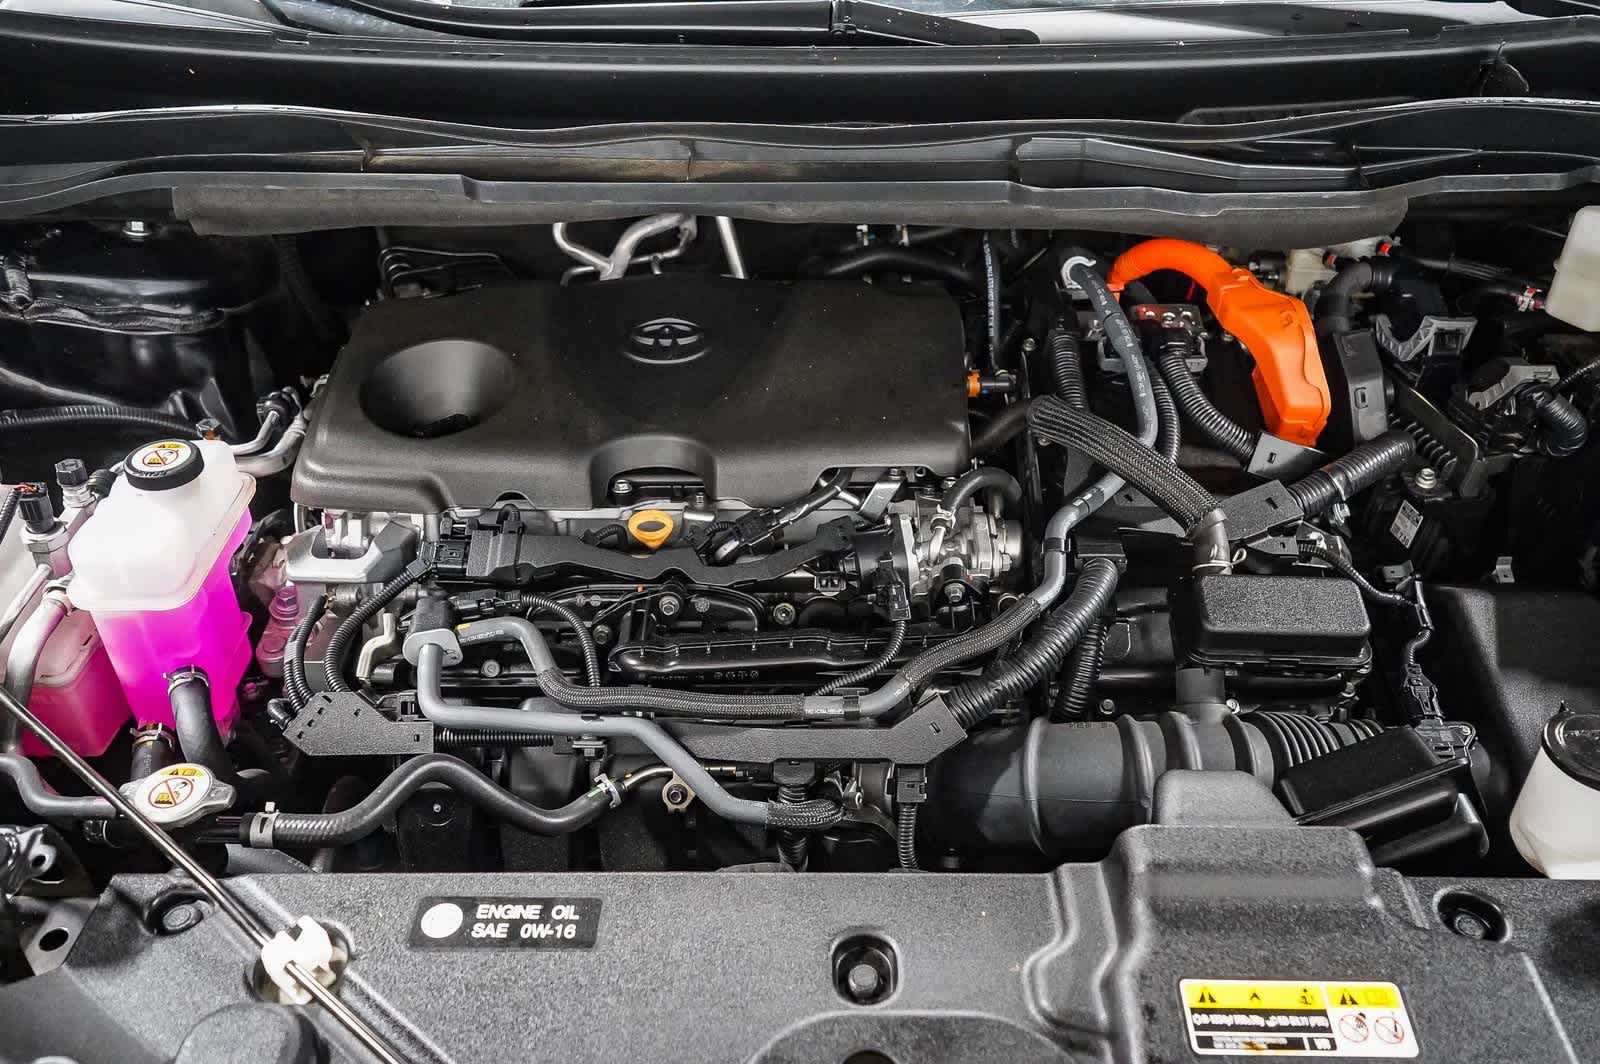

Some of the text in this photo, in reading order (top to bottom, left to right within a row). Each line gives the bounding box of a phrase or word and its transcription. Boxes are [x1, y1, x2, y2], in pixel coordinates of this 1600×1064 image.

[476, 904, 580, 920] ENGINE OIL
[471, 922, 577, 939] SAE 0W-16
